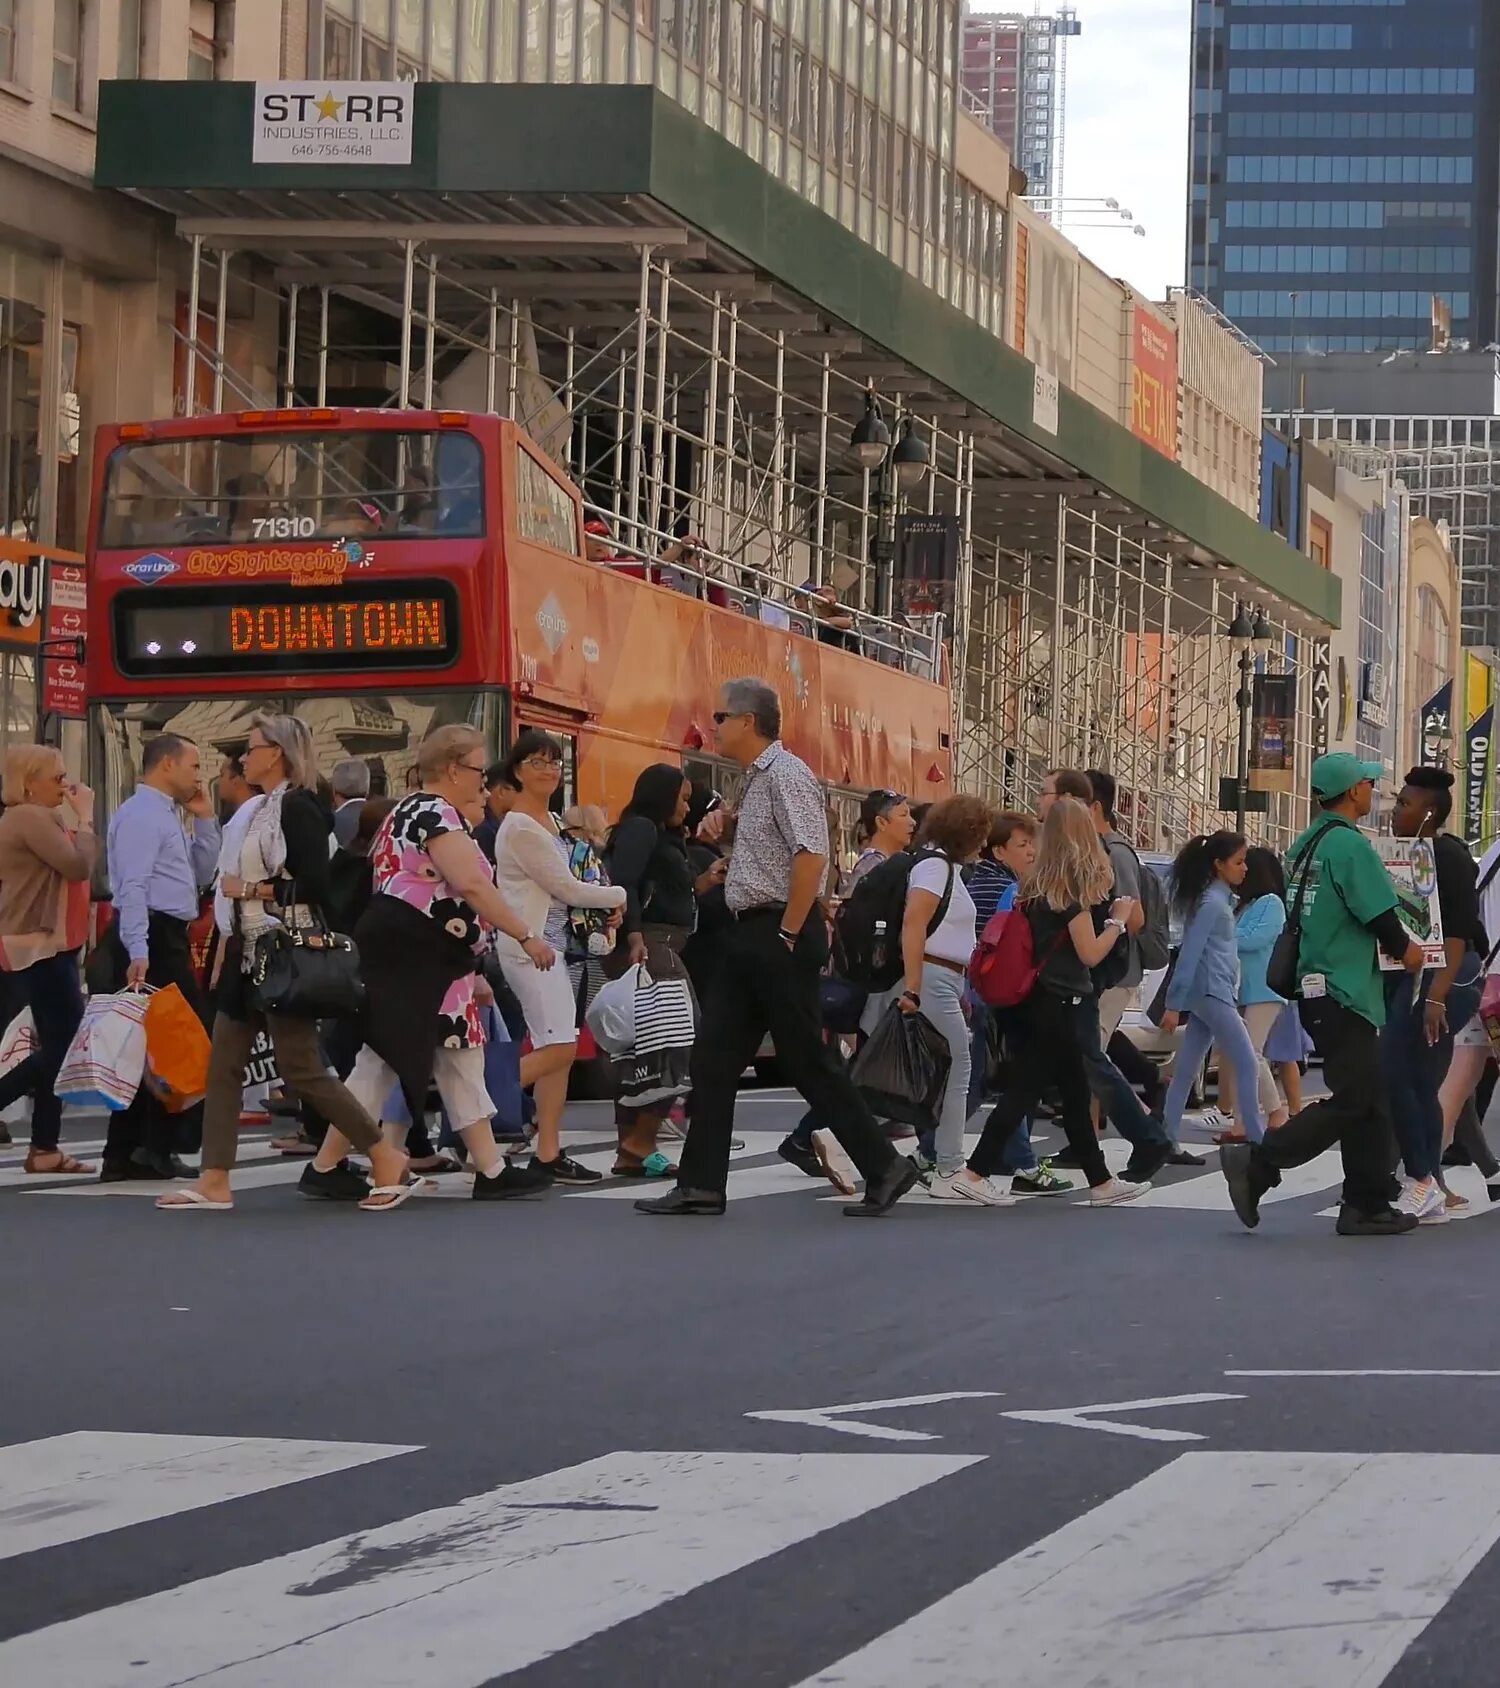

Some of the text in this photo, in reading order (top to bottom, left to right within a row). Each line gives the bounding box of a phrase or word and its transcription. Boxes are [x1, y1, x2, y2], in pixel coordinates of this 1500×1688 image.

[291, 144, 373, 156] 646-756-4648
[252, 517, 316, 538] 71310
[232, 601, 440, 650] DOWNTOWN
[1315, 644, 1330, 719] KAY
[1470, 736, 1489, 777] OLD
